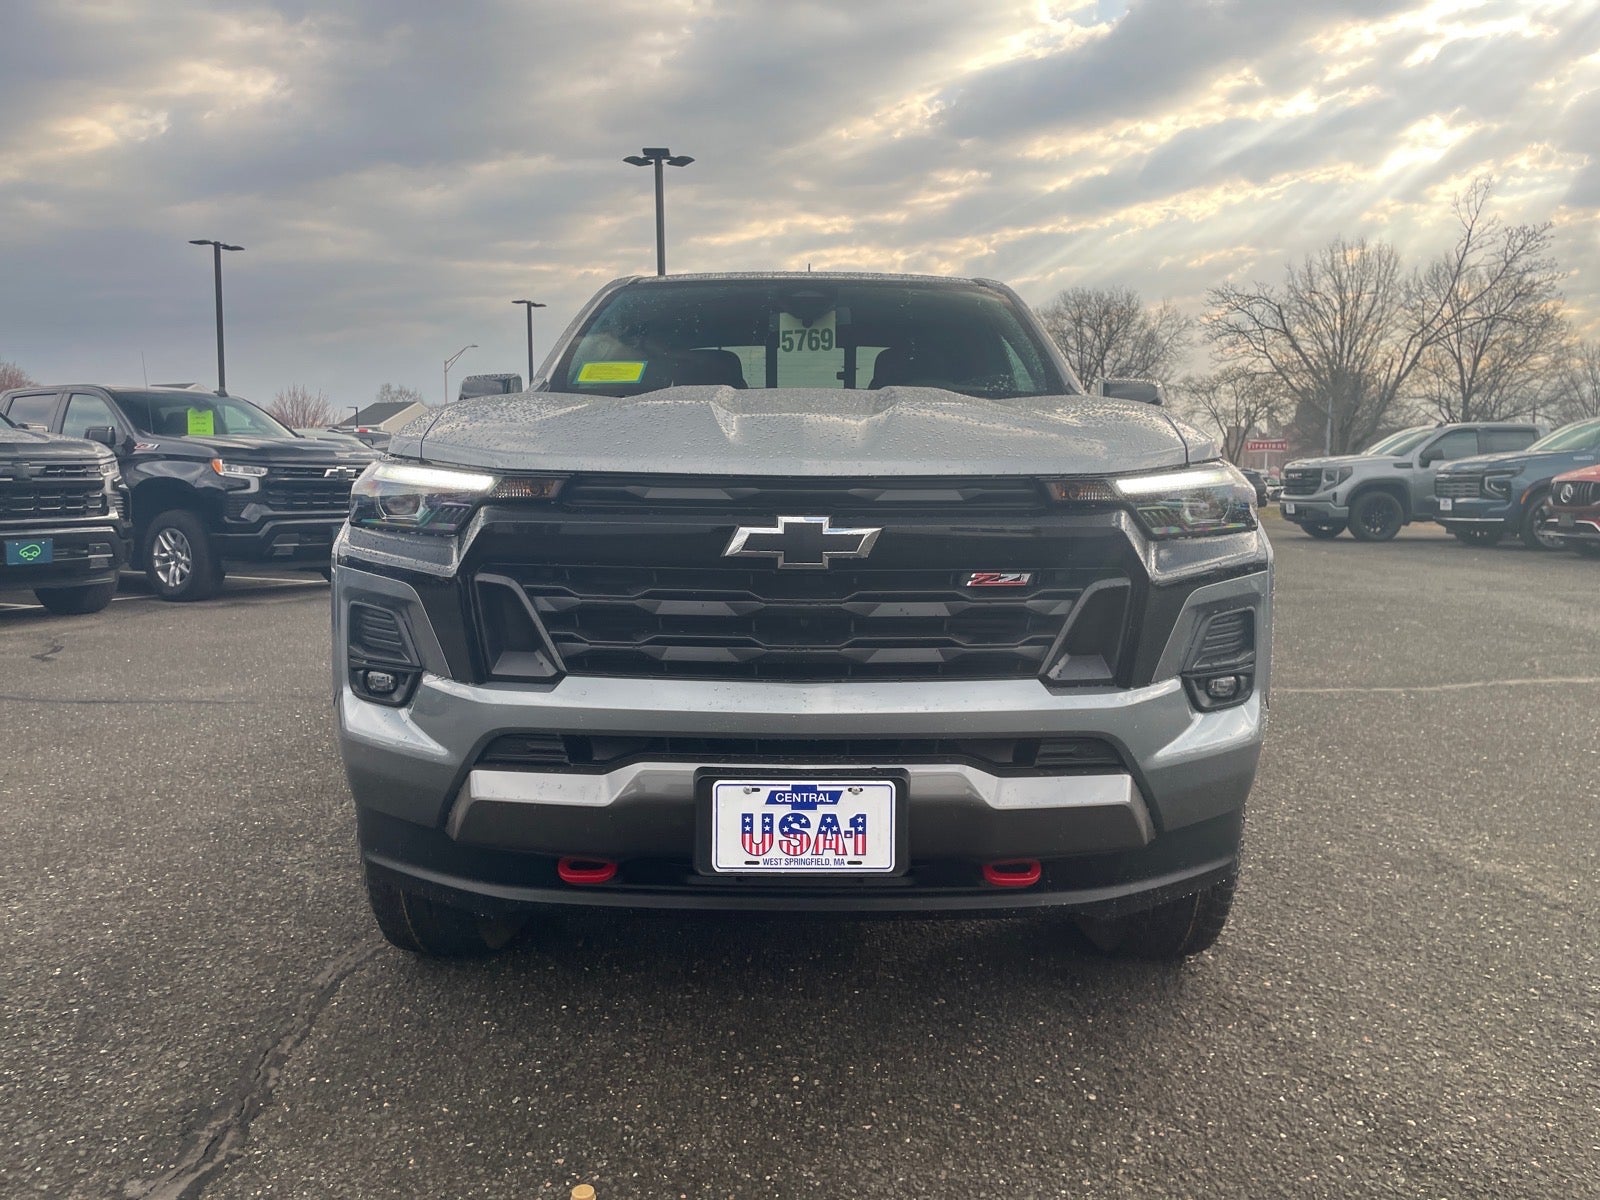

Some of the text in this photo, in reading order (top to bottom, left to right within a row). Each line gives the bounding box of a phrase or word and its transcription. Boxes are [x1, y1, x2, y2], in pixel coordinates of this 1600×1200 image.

[781, 327, 834, 353] 5769
[775, 792, 834, 803] CENTRAL
[762, 858, 846, 867] WEST SPRINGFIELD, MA
